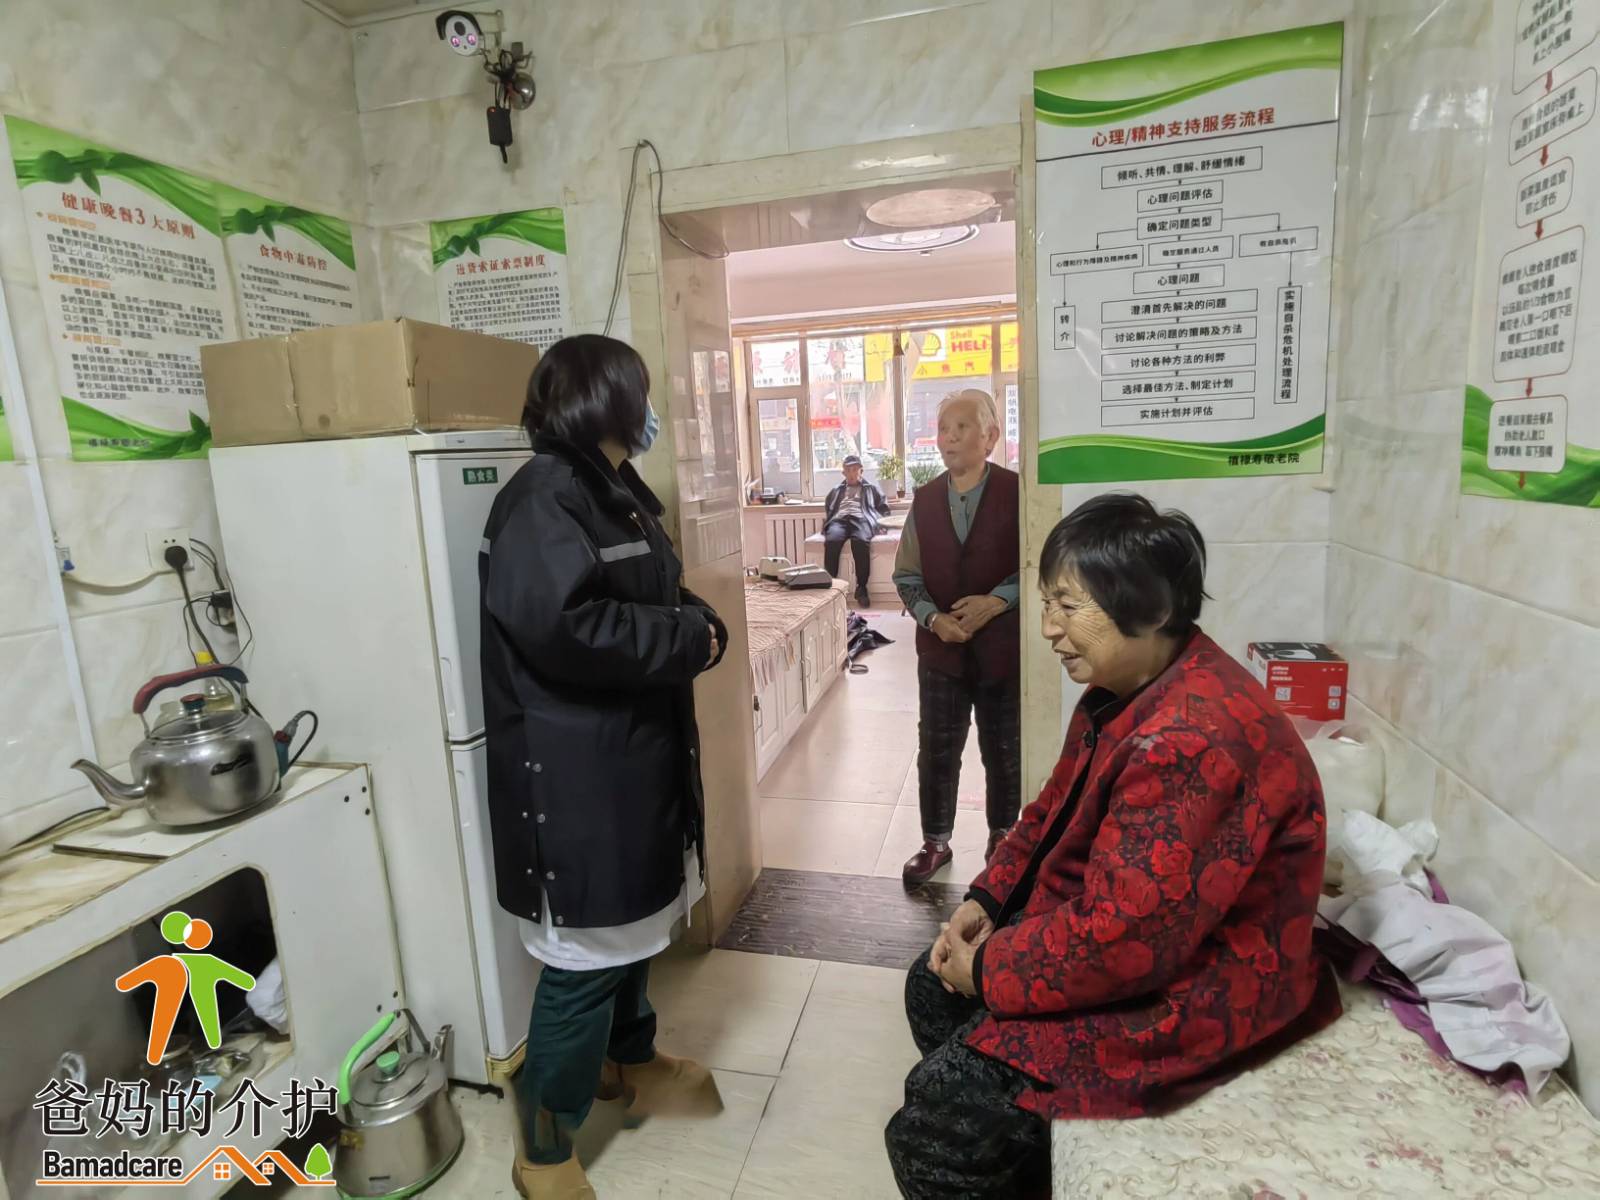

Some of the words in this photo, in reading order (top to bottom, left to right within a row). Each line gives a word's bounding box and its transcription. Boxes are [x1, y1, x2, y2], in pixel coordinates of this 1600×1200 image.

[1091, 107, 1275, 148] 心理/精神支持服务流程
[1117, 156, 1245, 182] 倾听、共情、理解、舒缓情绪
[1147, 188, 1213, 205] 心理问题评估
[1147, 216, 1212, 232] 确定问题类型
[1157, 272, 1200, 286] 心理问题
[1130, 298, 1227, 316] 澄清首先解决的问题
[1114, 324, 1243, 343] 讨论解决问题的策略及方法
[1280, 290, 1295, 400] 实施自杀危机处理流程
[1130, 352, 1226, 368] 讨论各种方法的利弊
[1122, 378, 1233, 395] 选择最佳方法、制定计划
[1140, 406, 1213, 419] 实施计划并评估
